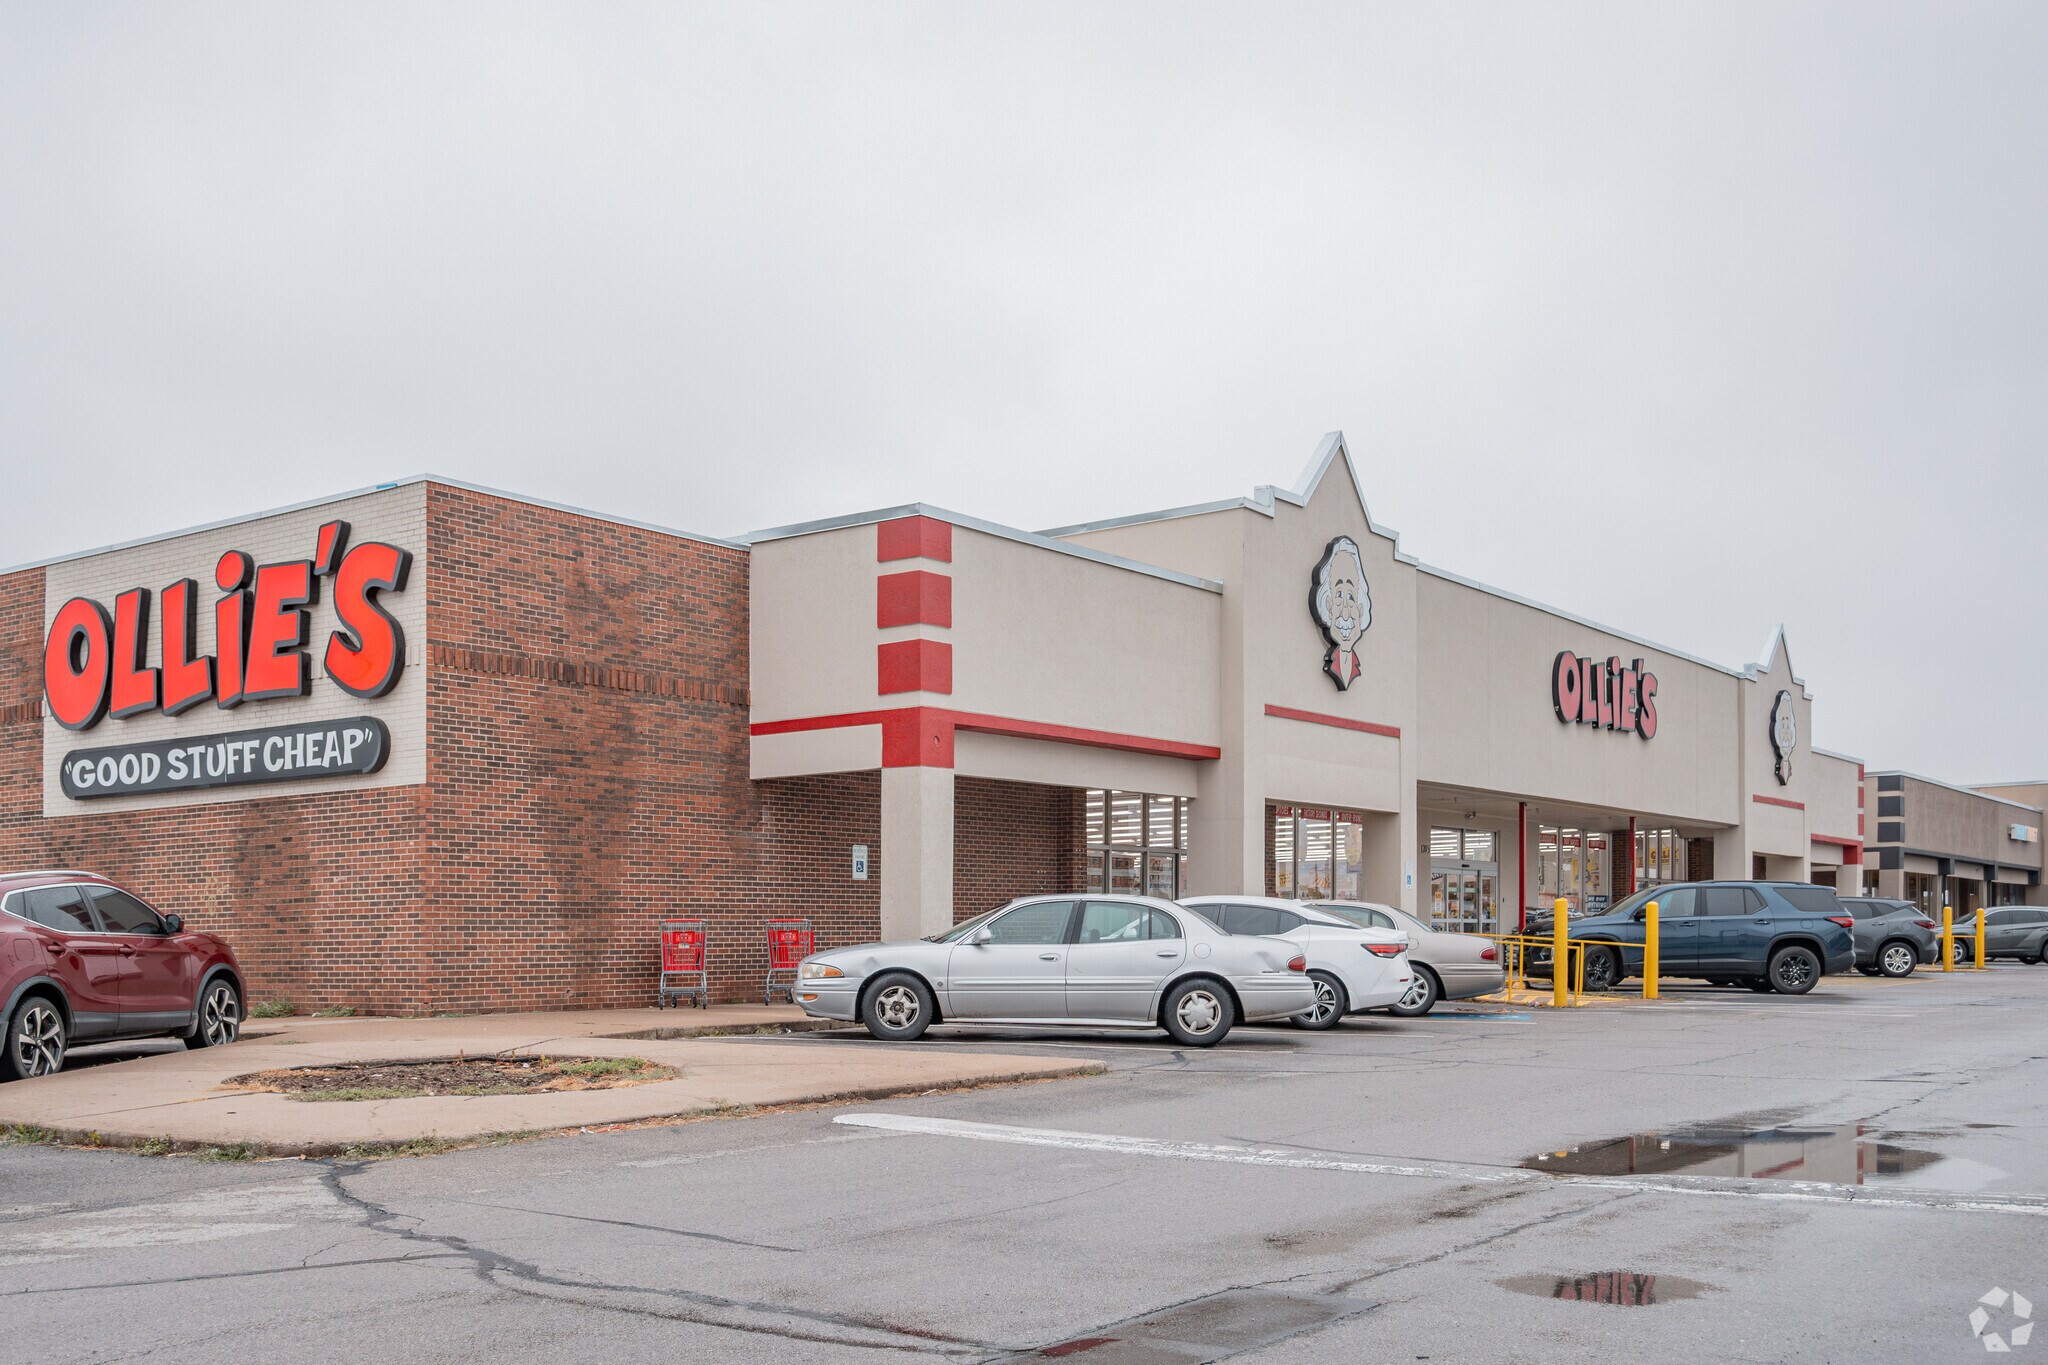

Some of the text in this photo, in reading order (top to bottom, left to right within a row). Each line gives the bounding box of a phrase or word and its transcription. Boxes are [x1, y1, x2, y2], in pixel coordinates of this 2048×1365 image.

[65, 727, 373, 788] "GOOD STUFF CHEAP"
